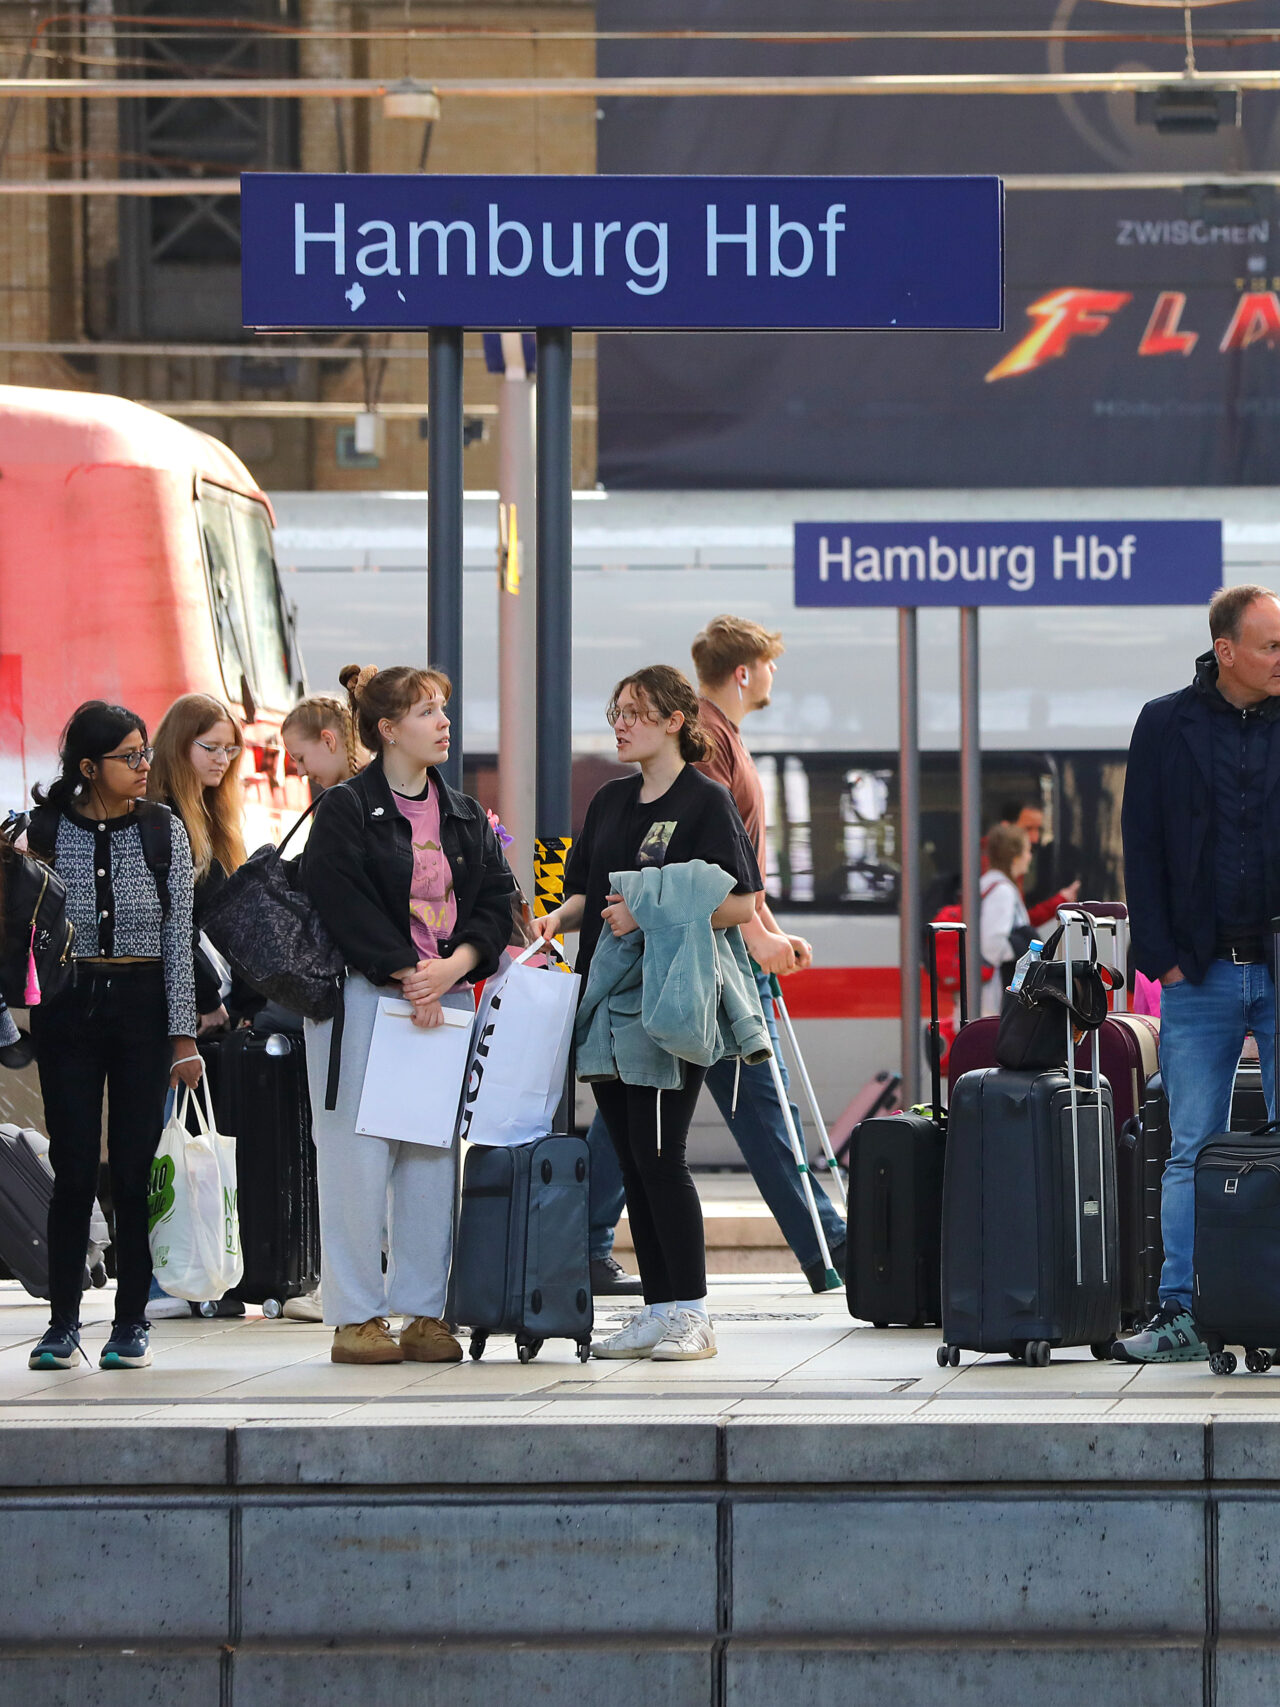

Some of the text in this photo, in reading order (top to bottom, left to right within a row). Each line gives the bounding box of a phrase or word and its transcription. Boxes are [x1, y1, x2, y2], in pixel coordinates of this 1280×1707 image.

[294, 202, 847, 296] Hamburg Hbf
[1115, 219, 1270, 246] ZWISCHEN
[818, 534, 1137, 592] Hamburg Hbf
